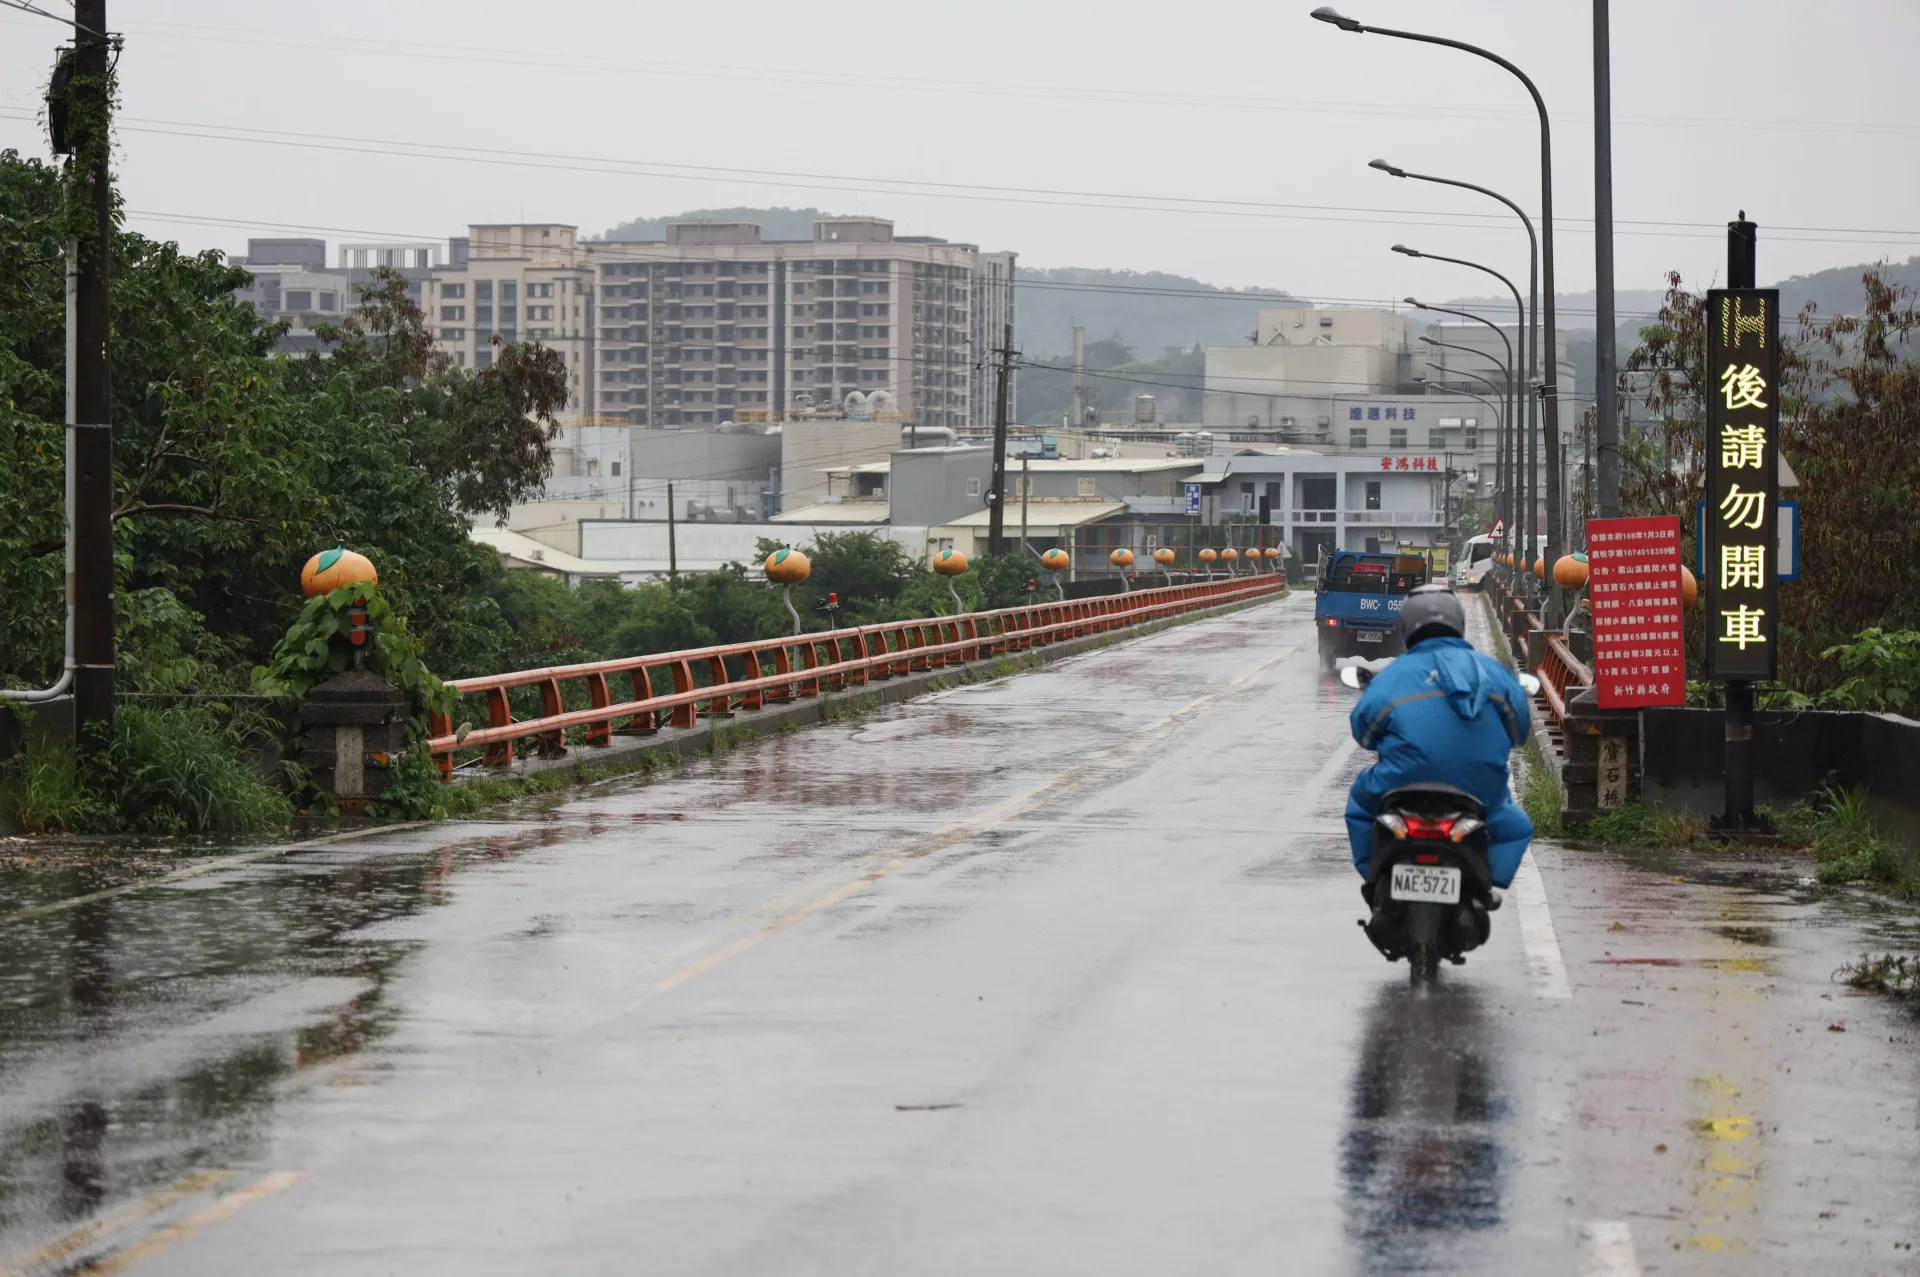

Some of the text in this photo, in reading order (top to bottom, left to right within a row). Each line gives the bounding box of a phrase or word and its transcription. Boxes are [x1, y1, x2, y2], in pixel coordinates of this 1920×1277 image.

[1381, 456, 1438, 471] 安鴻科技
[1593, 580, 1677, 593] 起至寶石大橋禁止使用
[1387, 599, 1403, 611] 055
[1614, 683, 1670, 696] 新竹縣政府
